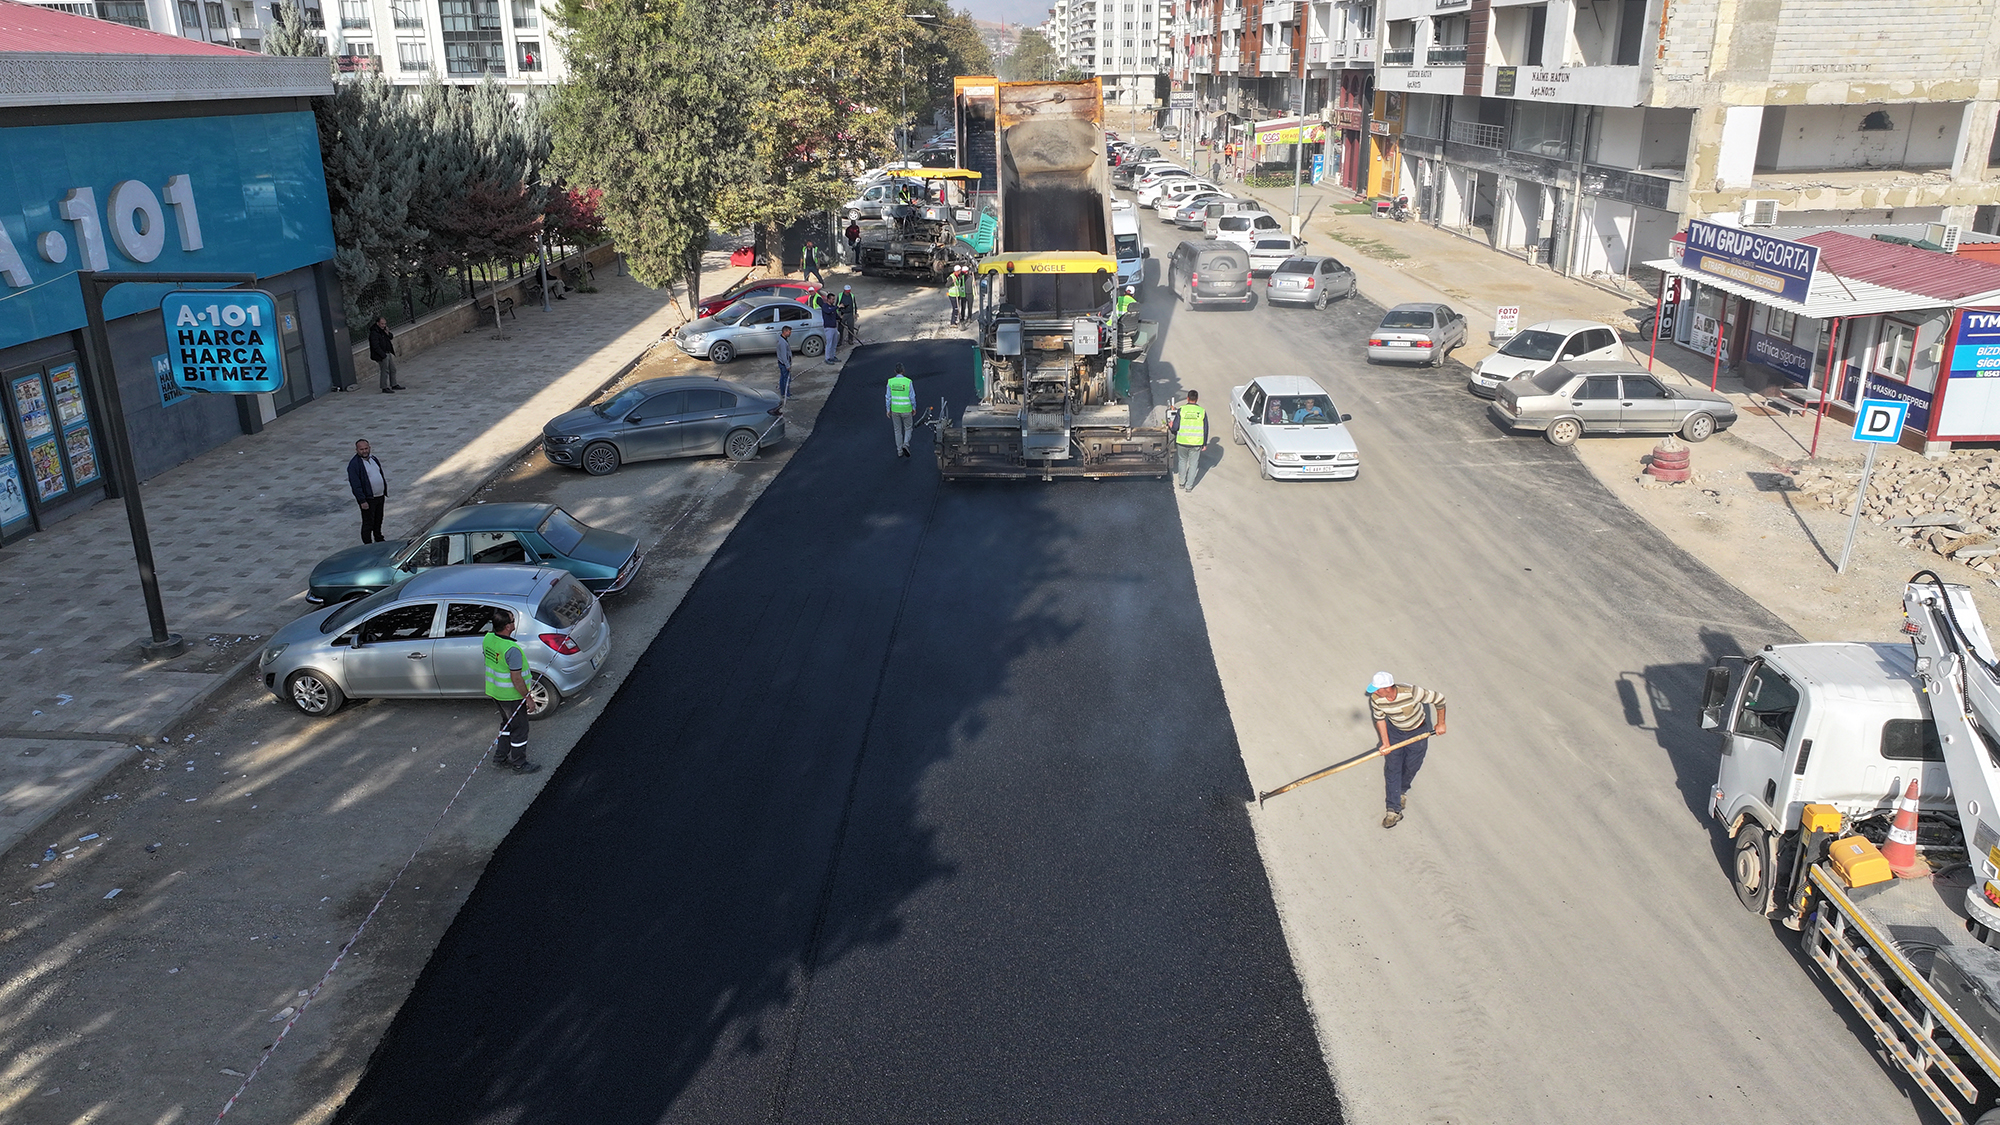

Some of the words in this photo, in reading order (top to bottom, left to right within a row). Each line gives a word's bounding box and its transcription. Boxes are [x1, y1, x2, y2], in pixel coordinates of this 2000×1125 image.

[1550, 72, 1570, 82] HATUN
[1691, 222, 1717, 248] TYM
[1717, 229, 1753, 257] GRUP
[1031, 263, 1066, 272] VÖGELE
[1730, 268, 1749, 281] KASKO
[1754, 274, 1781, 290] DEPREM
[177, 330, 264, 346] HARCA
[1709, 336, 1726, 351] FOO
[181, 348, 267, 364] HARCA
[1756, 339, 1779, 359] ethica
[1779, 350, 1807, 370] sigorta
[1876, 384, 1897, 398] KASKO
[1901, 394, 1929, 411] DEPREM
[1868, 410, 1891, 432] D
